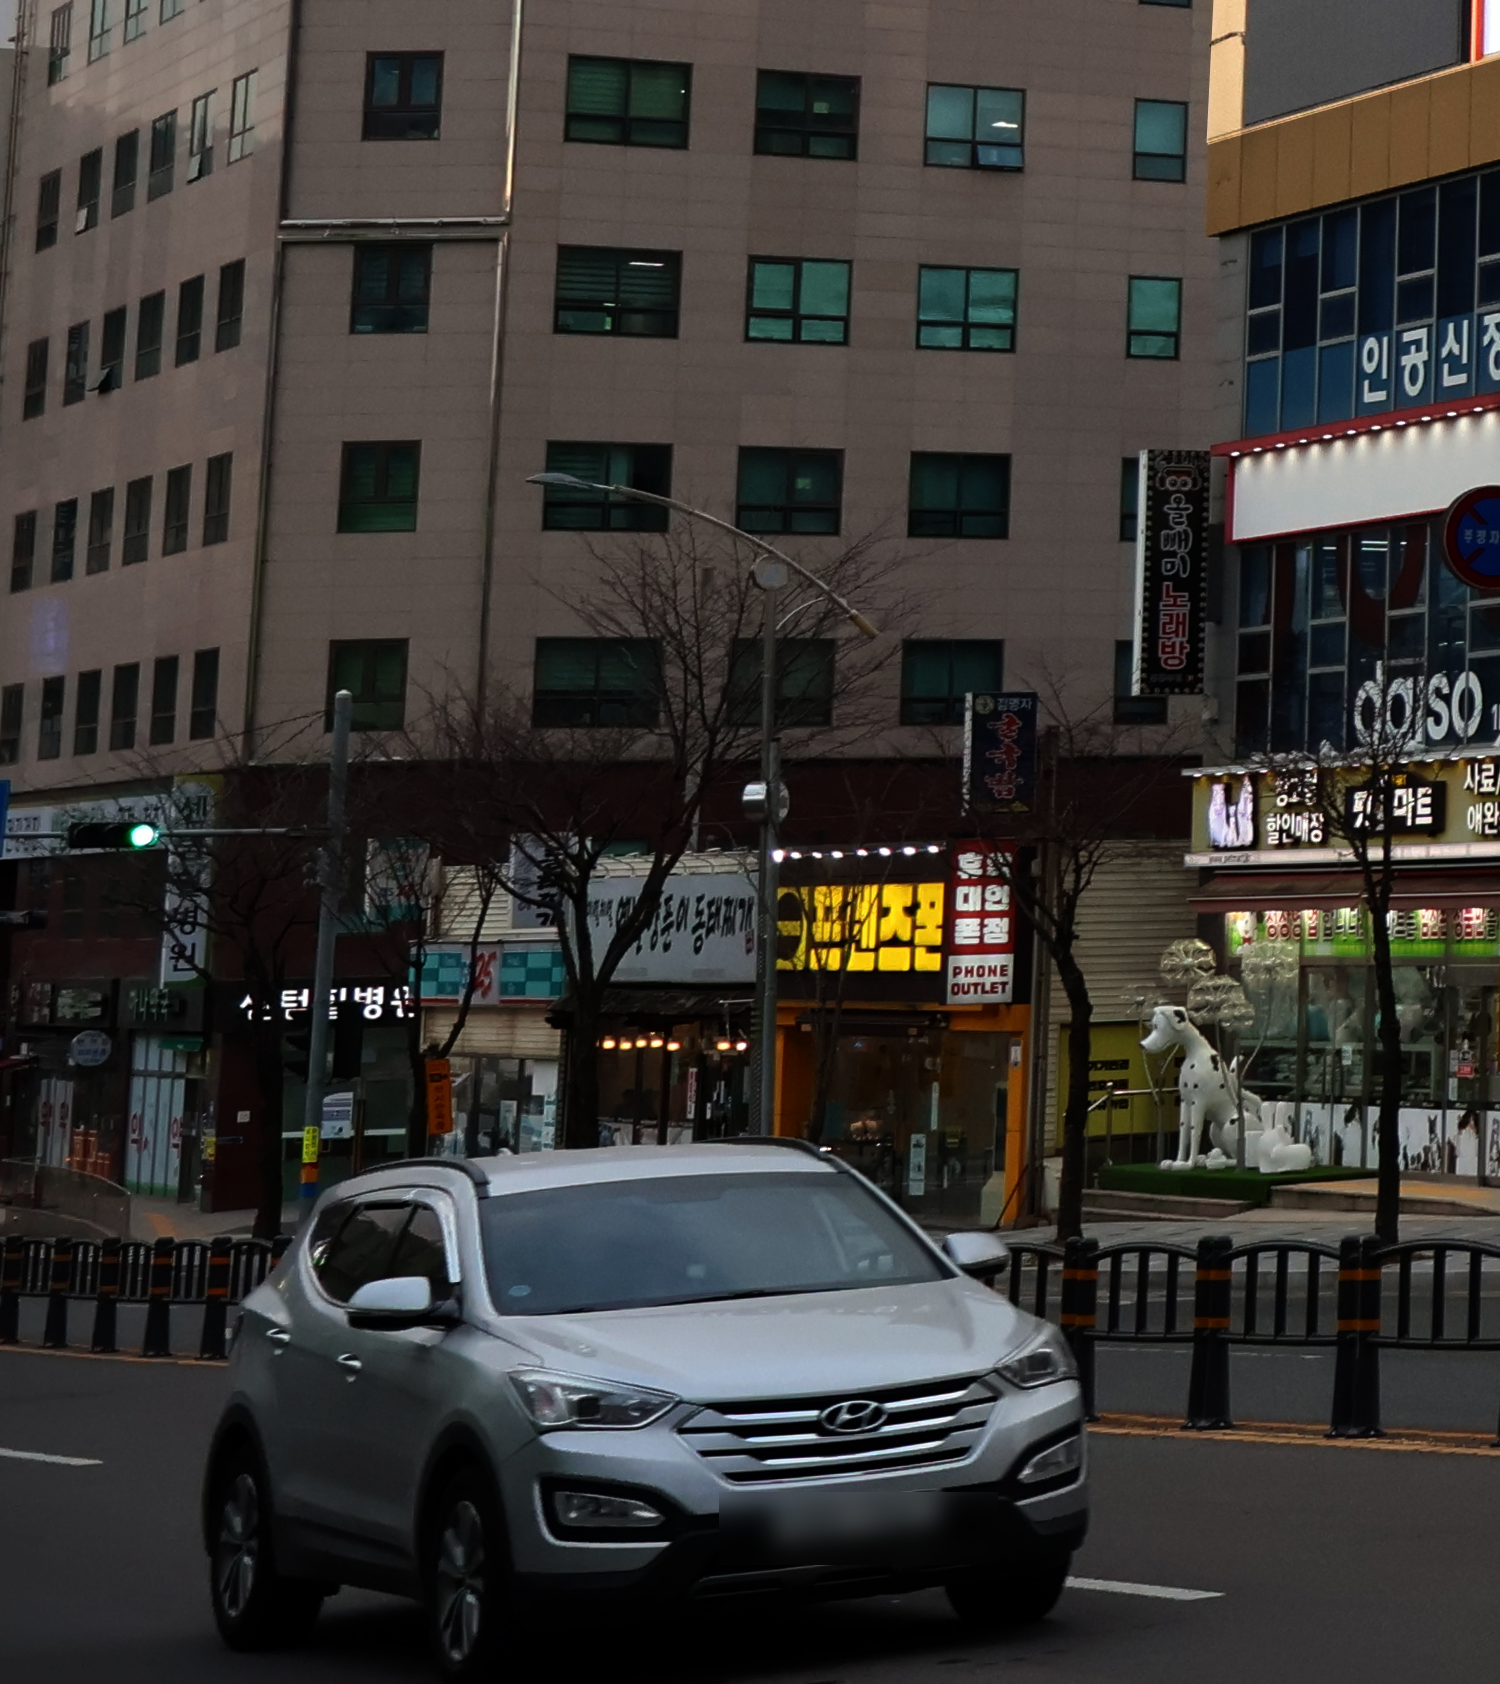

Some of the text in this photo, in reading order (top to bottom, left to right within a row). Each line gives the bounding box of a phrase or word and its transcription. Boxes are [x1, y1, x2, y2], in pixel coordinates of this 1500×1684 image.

[1266, 812, 1323, 844] 할인매장
[953, 965, 1008, 977] PHONE
[952, 982, 1008, 995] OUTLET
